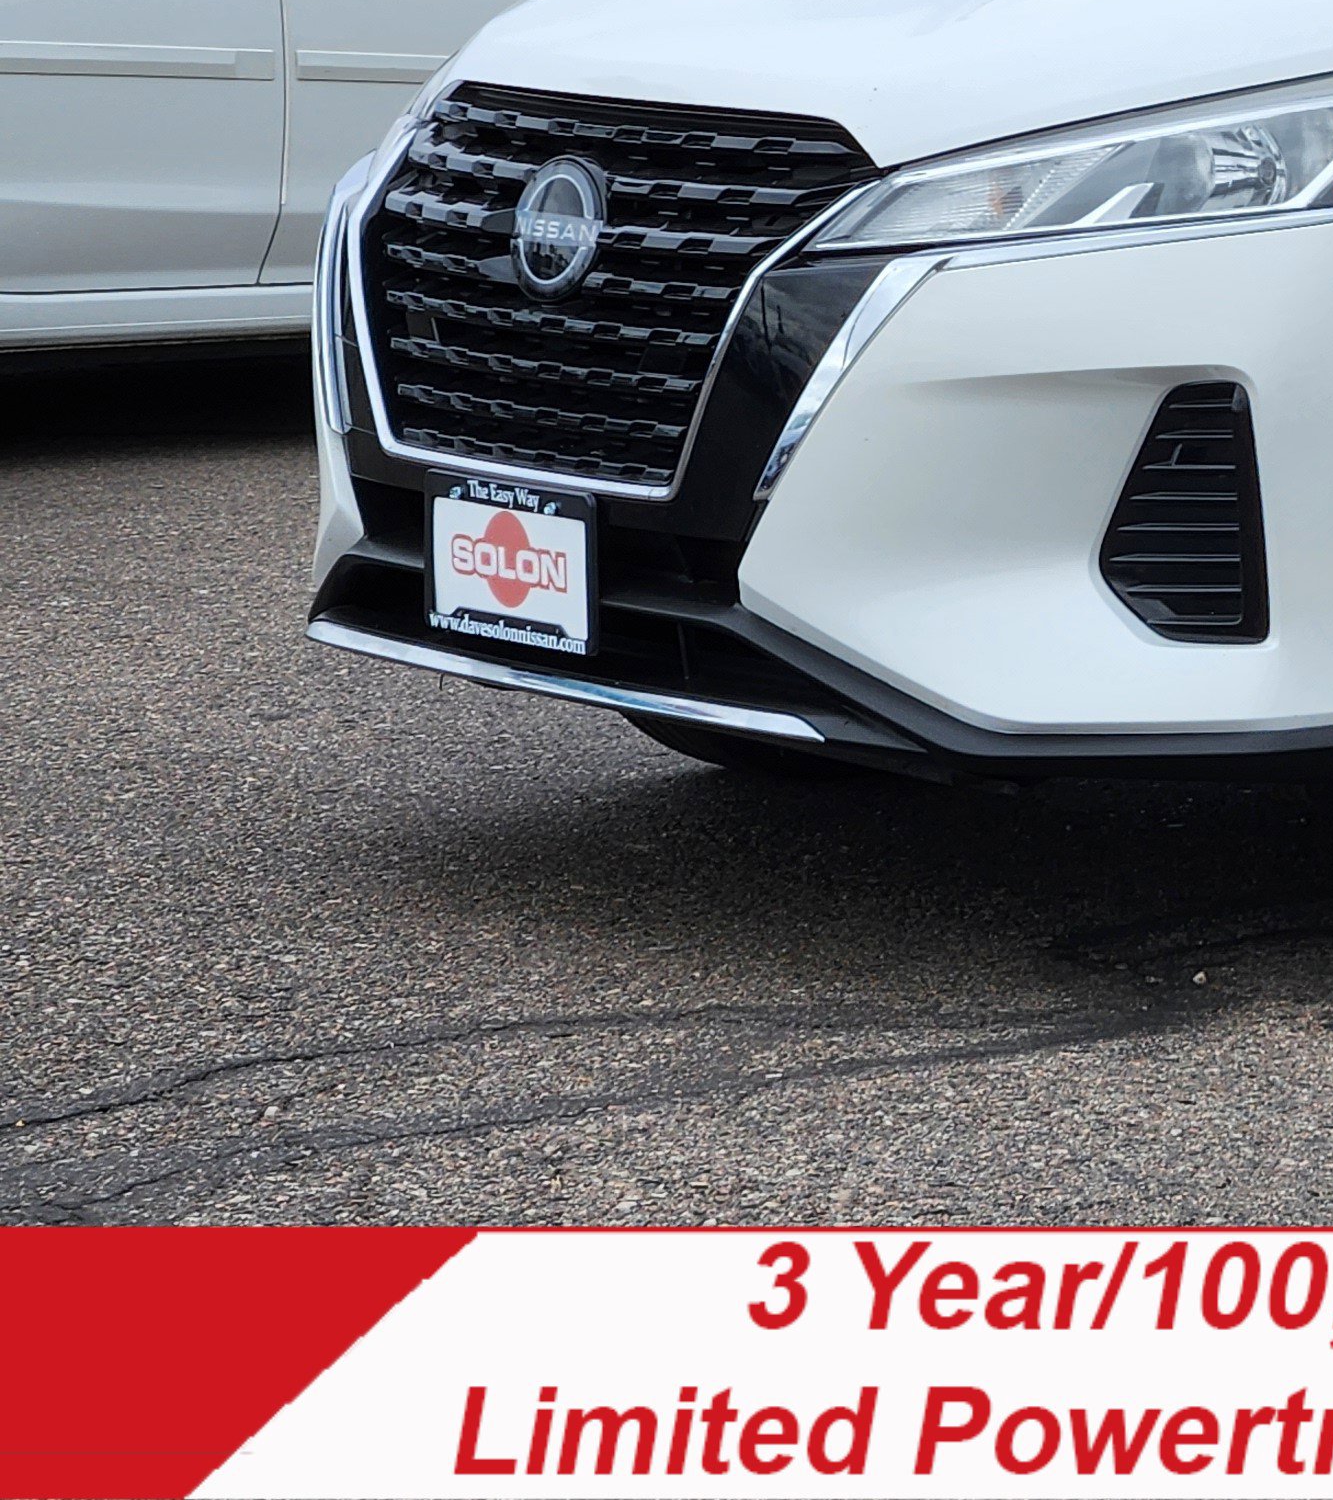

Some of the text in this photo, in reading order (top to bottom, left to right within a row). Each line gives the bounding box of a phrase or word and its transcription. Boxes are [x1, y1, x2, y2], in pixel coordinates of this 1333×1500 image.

[514, 213, 597, 243] NISSAN
[467, 479, 541, 513] The Easy Way
[451, 533, 568, 594] SOLON
[428, 612, 587, 656] www.davesolonnissan.com
